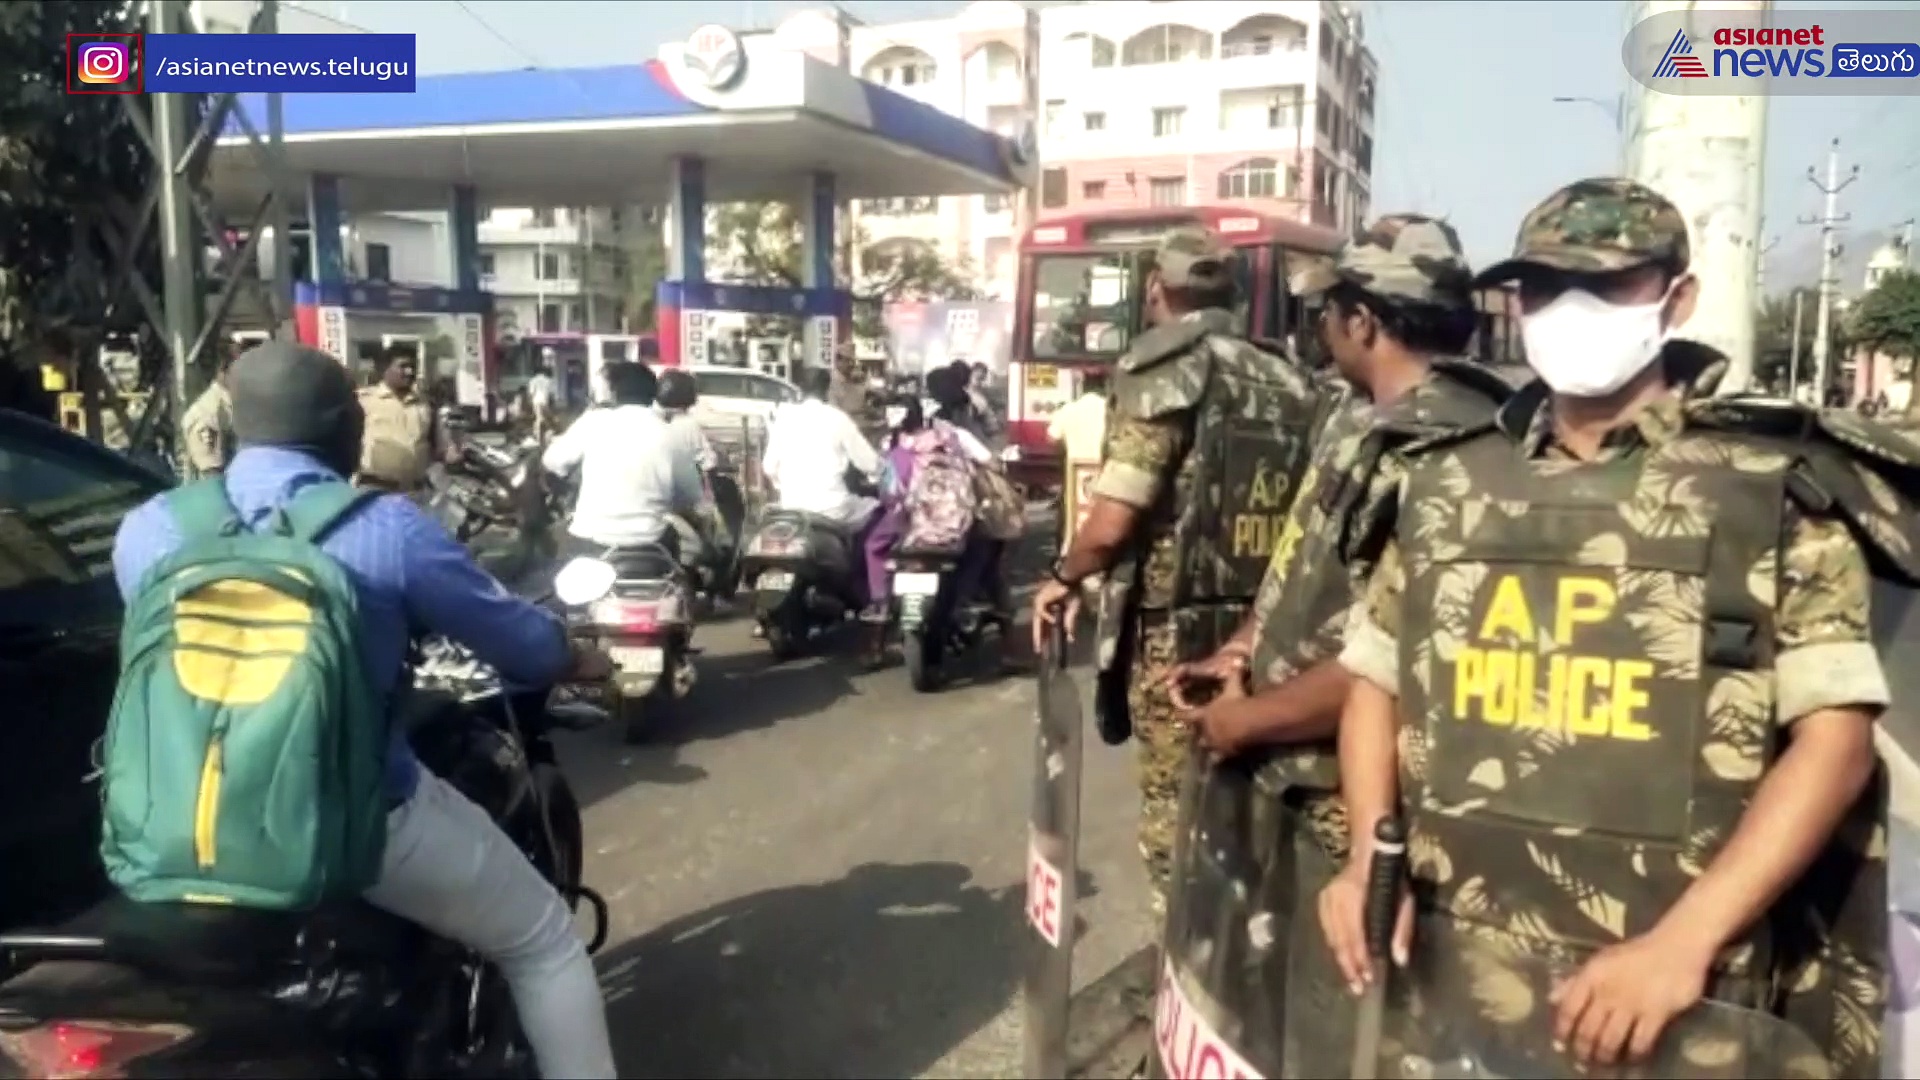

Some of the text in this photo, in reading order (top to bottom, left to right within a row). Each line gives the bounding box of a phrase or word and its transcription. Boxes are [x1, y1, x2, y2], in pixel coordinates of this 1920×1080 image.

[1478, 574, 1617, 646] A P
[1454, 648, 1656, 741] POLICE
